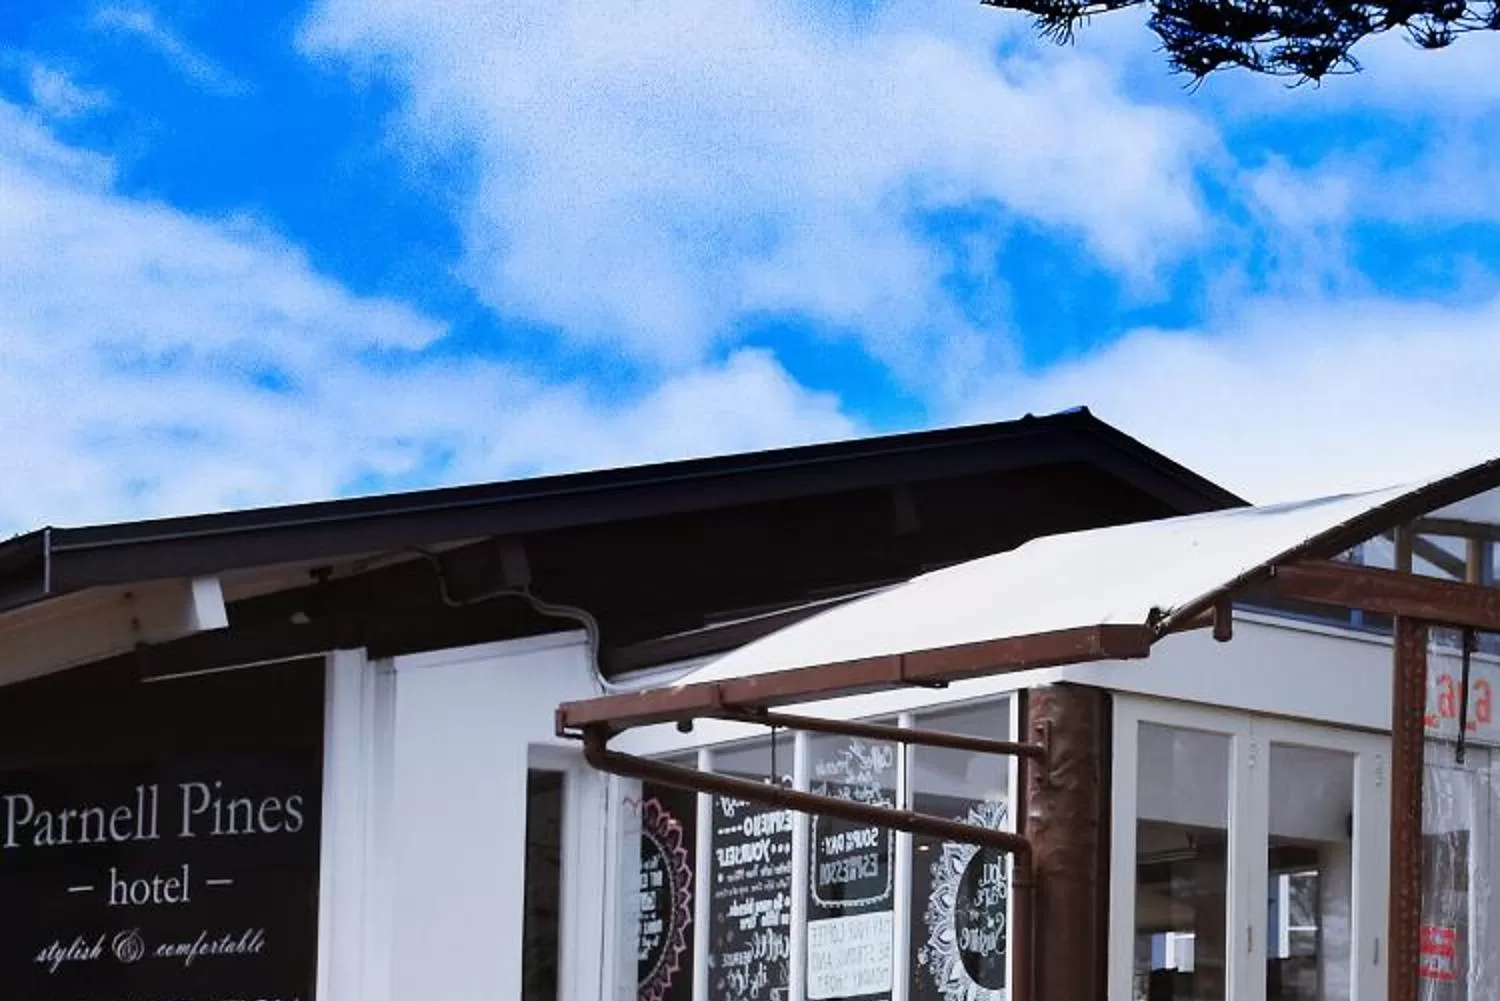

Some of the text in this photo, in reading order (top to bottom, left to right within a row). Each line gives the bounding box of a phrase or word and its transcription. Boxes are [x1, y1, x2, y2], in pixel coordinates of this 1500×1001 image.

[0, 781, 304, 848] Parnell Pines
[108, 864, 190, 905] hotel
[34, 934, 106, 974] stylish
[153, 927, 266, 967] comfortable
